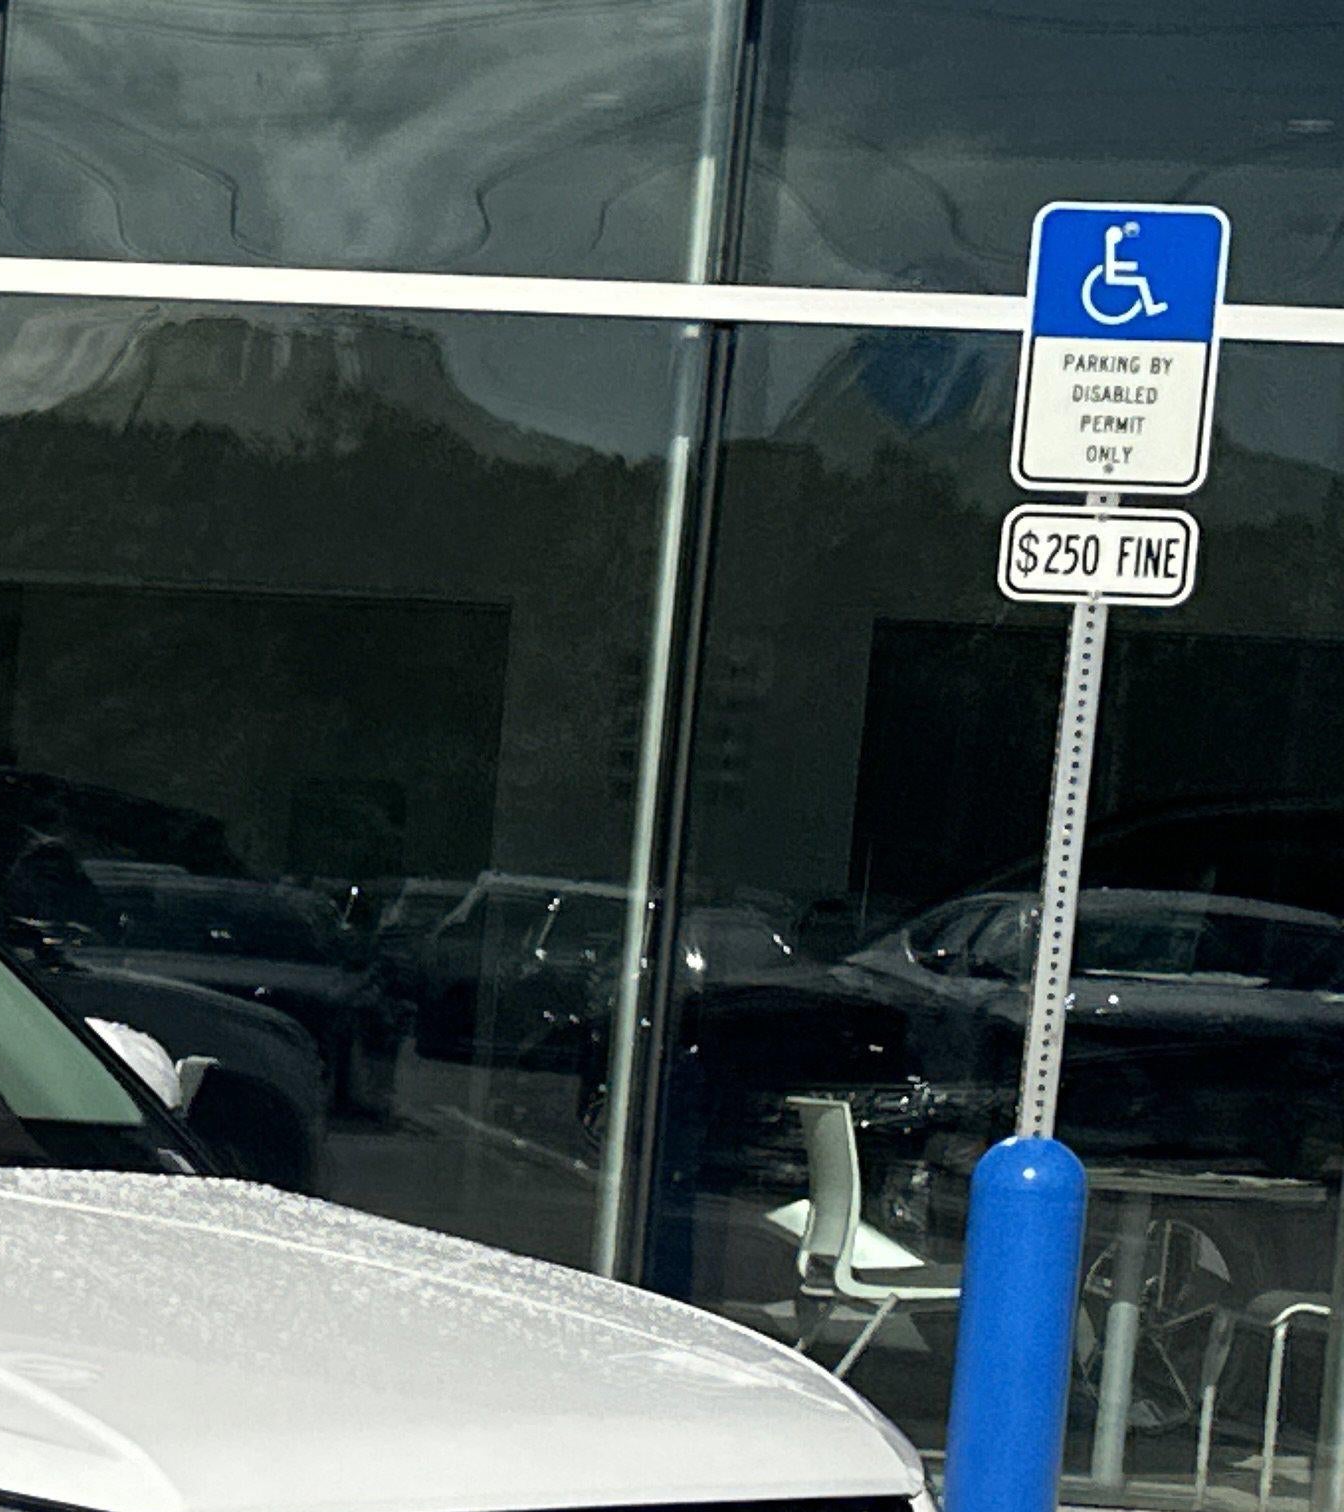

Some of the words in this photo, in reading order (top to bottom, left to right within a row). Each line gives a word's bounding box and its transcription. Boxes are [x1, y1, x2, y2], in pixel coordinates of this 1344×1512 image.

[1062, 353, 1140, 375] PARKING
[1149, 356, 1173, 376] BY
[1072, 384, 1158, 405] DISABLED
[1080, 415, 1145, 434] PERMIT
[1086, 445, 1133, 465] ONLY
[1016, 530, 1100, 577] $250
[1116, 536, 1180, 579] FINE
